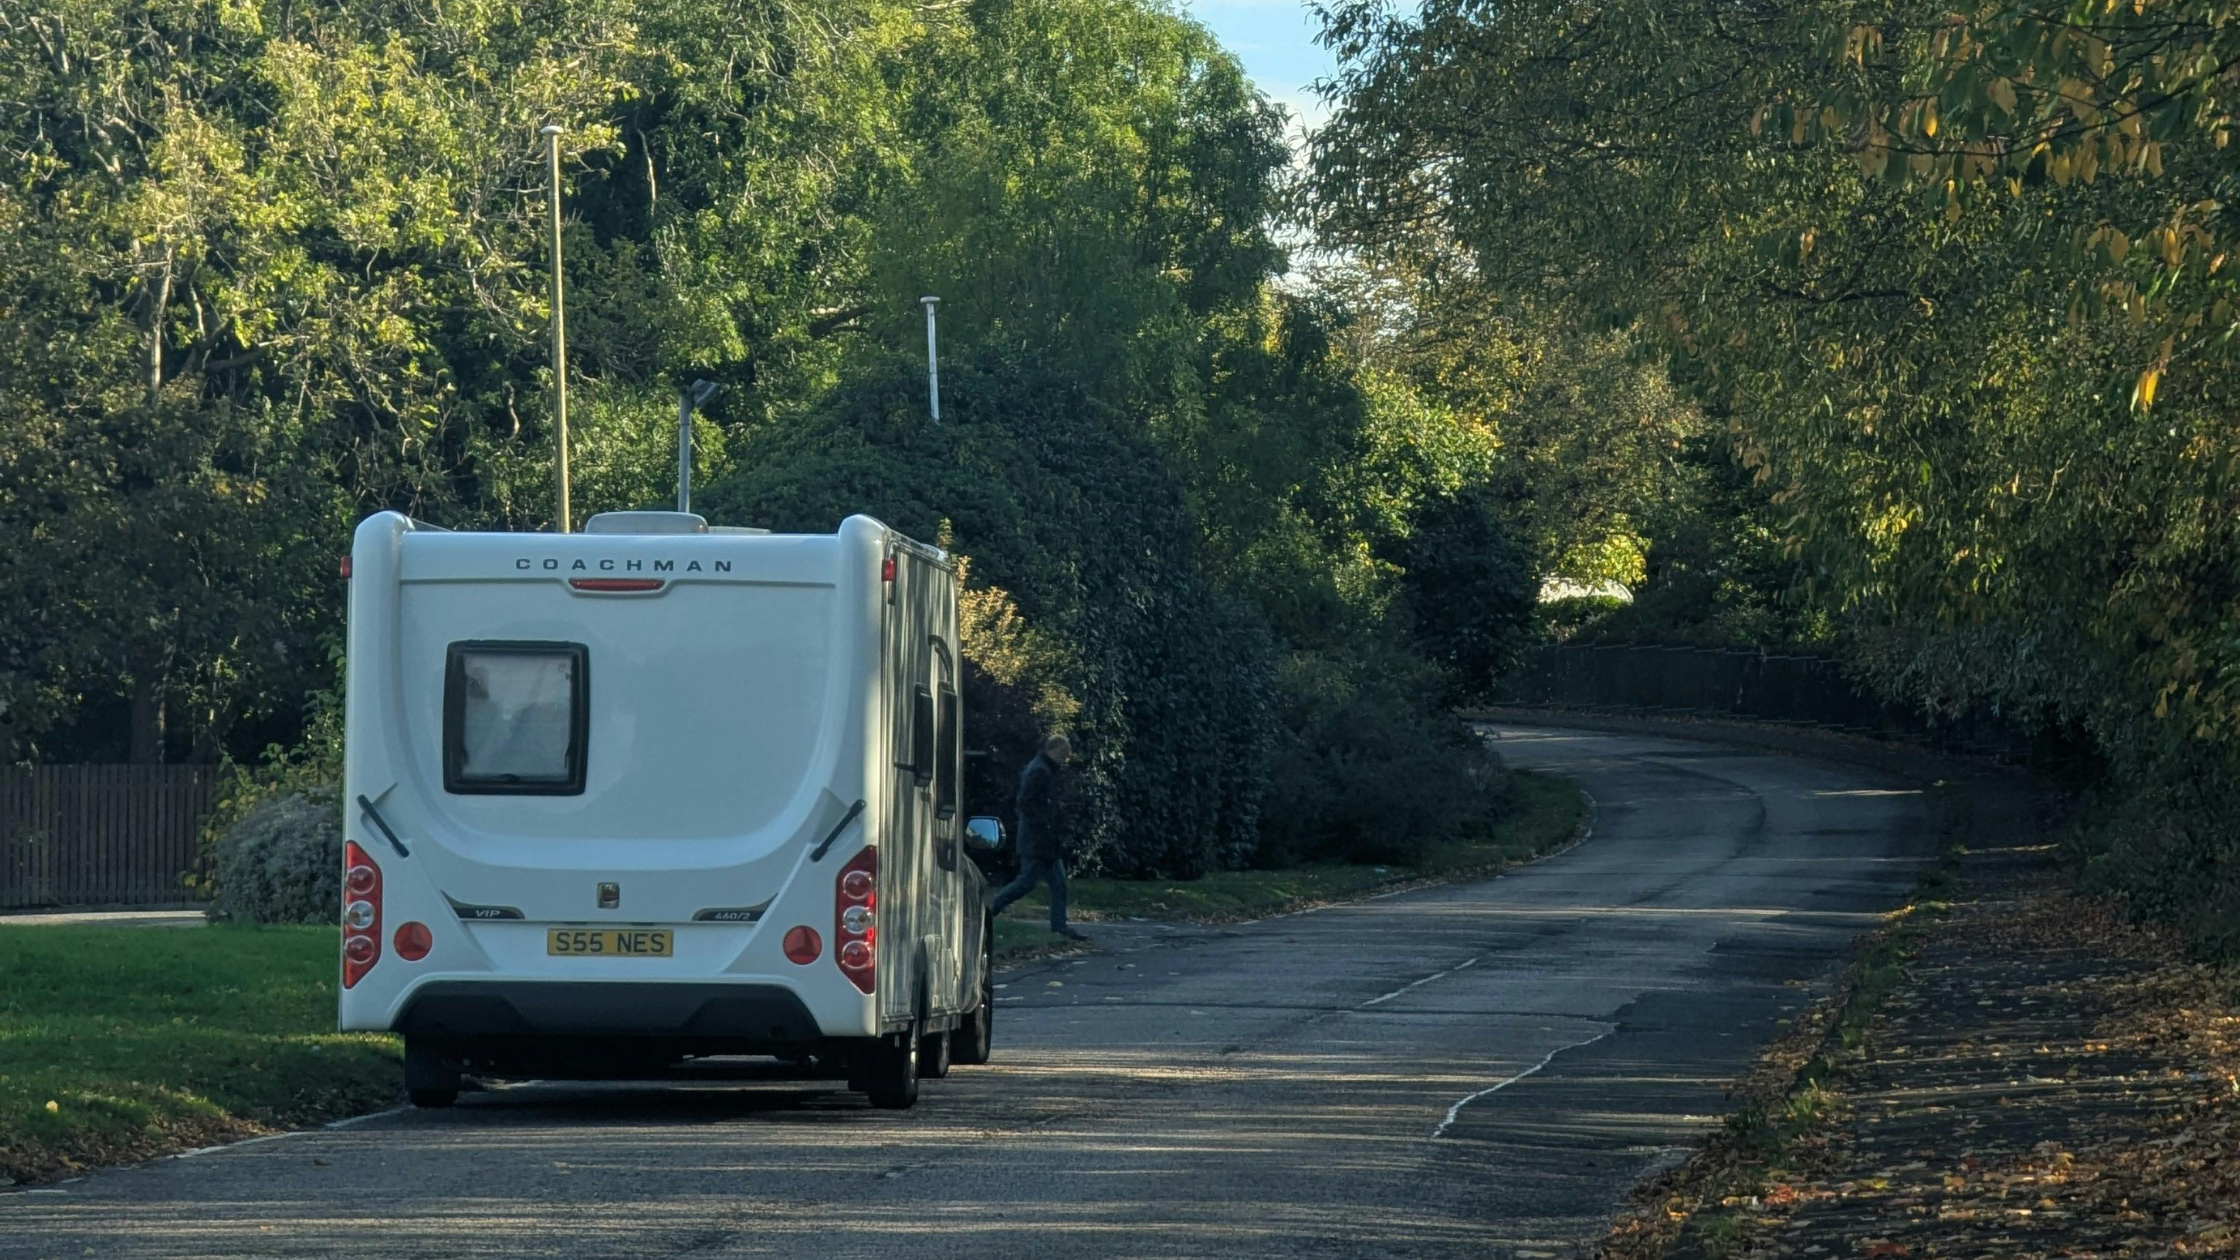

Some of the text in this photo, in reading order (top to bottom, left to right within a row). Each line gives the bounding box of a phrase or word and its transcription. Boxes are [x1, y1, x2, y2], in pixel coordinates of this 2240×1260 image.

[515, 558, 732, 572] COACHMAN
[475, 909, 501, 918] VIP
[714, 911, 751, 920] 460/2
[556, 932, 665, 953] S55 NES
